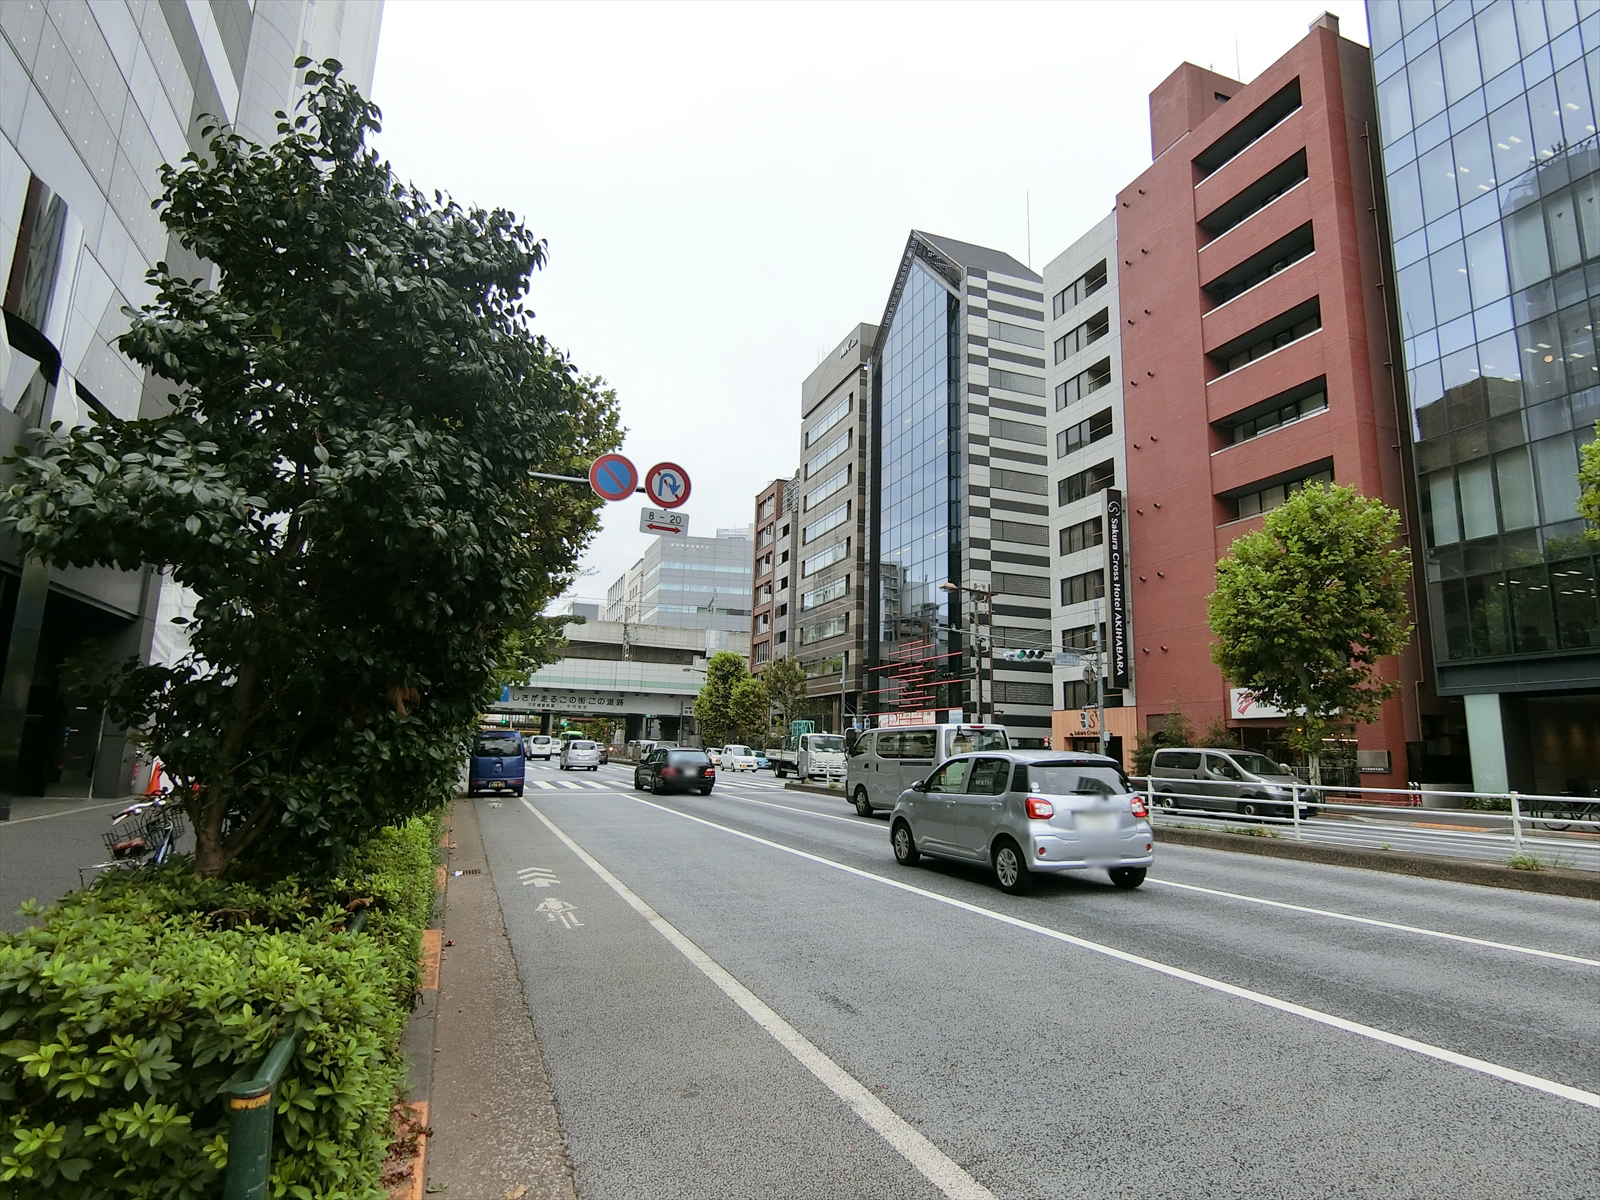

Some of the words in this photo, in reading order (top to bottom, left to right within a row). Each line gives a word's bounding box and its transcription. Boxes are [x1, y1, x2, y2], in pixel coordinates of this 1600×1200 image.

[649, 511, 654, 520] 8
[670, 515, 682, 524] 20
[1111, 517, 1120, 550] Sakura
[1112, 552, 1121, 581] Cross
[1113, 583, 1123, 611] Hotel
[1114, 613, 1124, 676] AKIHABARA
